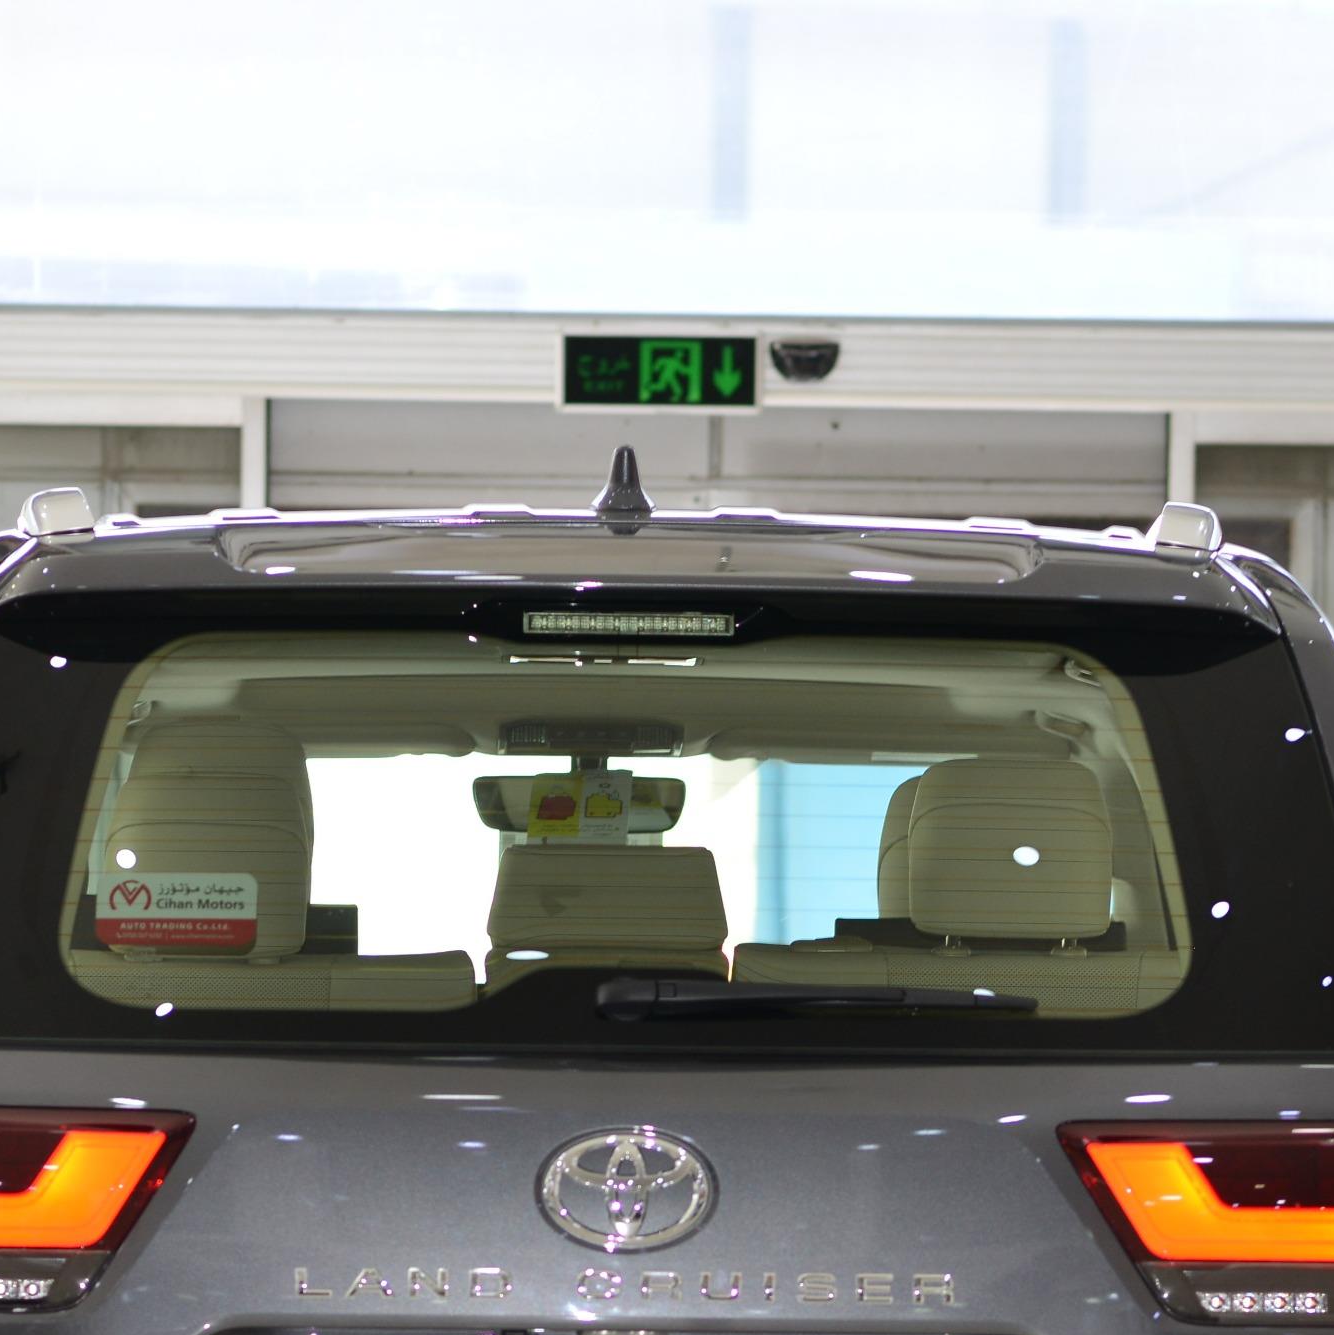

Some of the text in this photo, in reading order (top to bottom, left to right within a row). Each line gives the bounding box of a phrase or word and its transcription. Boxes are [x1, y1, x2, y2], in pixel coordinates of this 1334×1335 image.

[156, 898, 245, 910] Cihan Motors
[120, 922, 147, 930] AUTO
[294, 1267, 956, 1304] LAND CRUISER
